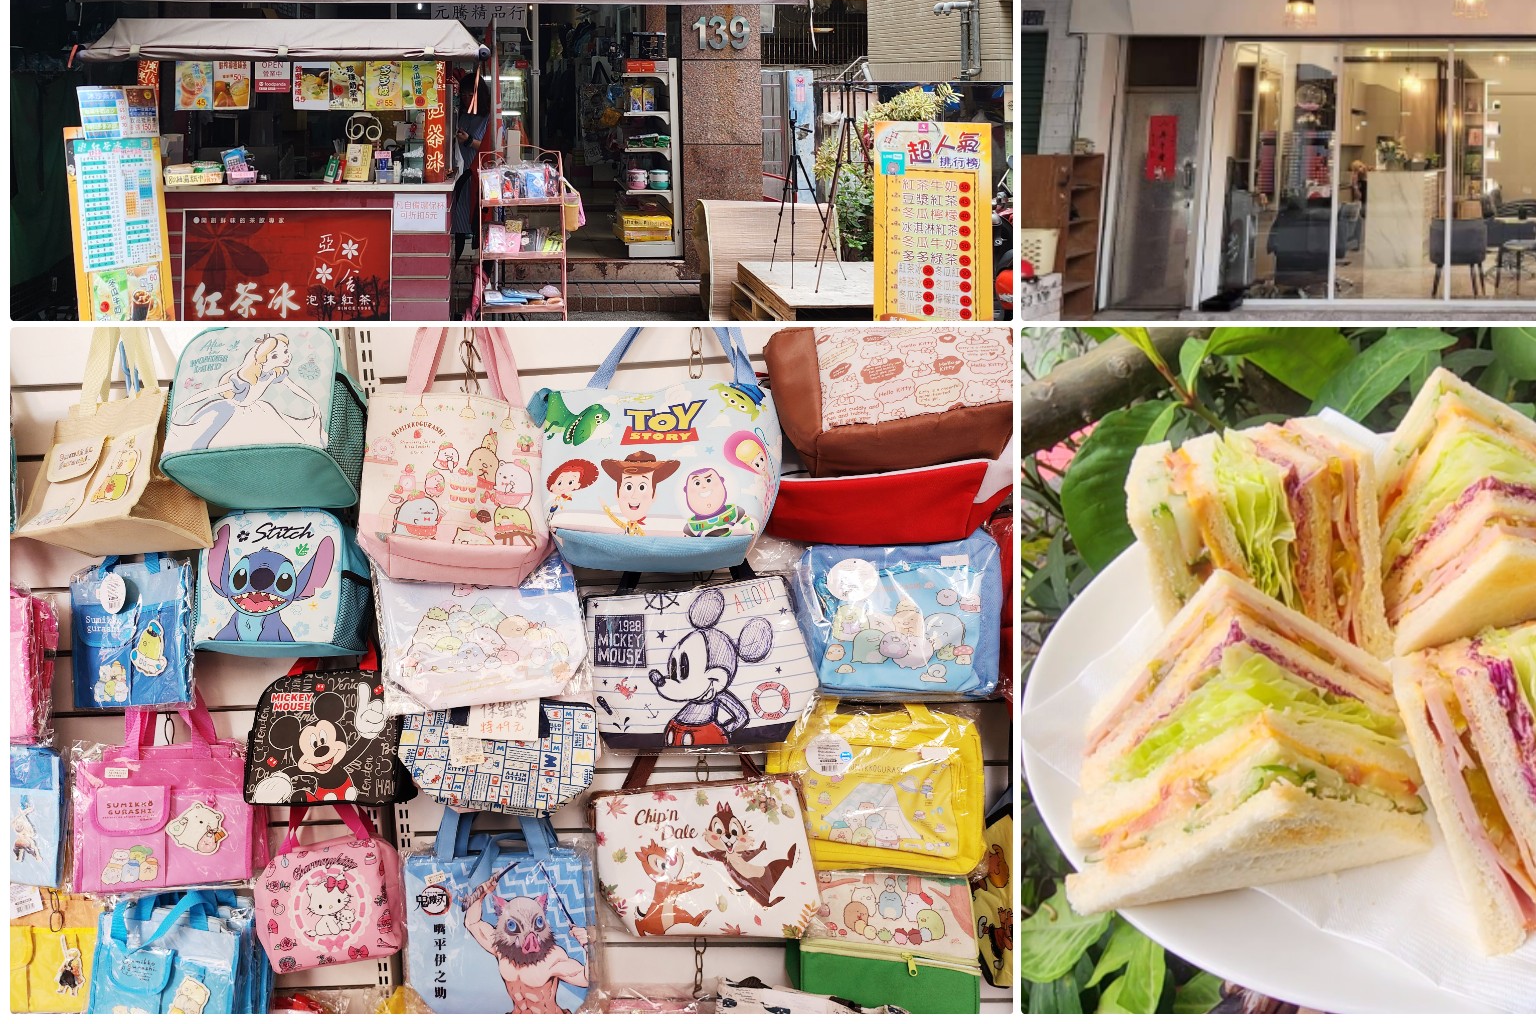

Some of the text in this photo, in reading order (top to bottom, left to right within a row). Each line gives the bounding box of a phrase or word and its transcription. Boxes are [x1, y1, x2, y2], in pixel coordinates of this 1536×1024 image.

[692, 15, 751, 51] 139
[907, 132, 980, 165] 超人氣
[940, 156, 980, 168] 排行榜
[902, 179, 958, 193] 紅茶牛奶
[902, 192, 958, 206] 豆漿紅茶
[902, 207, 958, 221] 冬瓜檸檬
[902, 222, 958, 236] 冰淇淋紅茶
[317, 233, 335, 254] 亞
[902, 235, 958, 250] 冬瓜牛奶
[902, 250, 958, 265] 多多綠茶
[192, 281, 302, 319] 紅茶冰
[306, 293, 371, 306] 泡沫紅茶
[623, 399, 708, 432] TOY
[628, 431, 692, 444] STORY
[252, 521, 316, 544] Stitch
[618, 621, 642, 633] 1928
[598, 633, 644, 648] MICKEY
[598, 649, 644, 665] MOUSE
[271, 692, 314, 702] MICKEY
[273, 701, 312, 712] MOUSE
[660, 821, 699, 841] Dale
[415, 891, 451, 910] 鬼滅刃
[433, 923, 448, 1000] 嘴平伊之助
